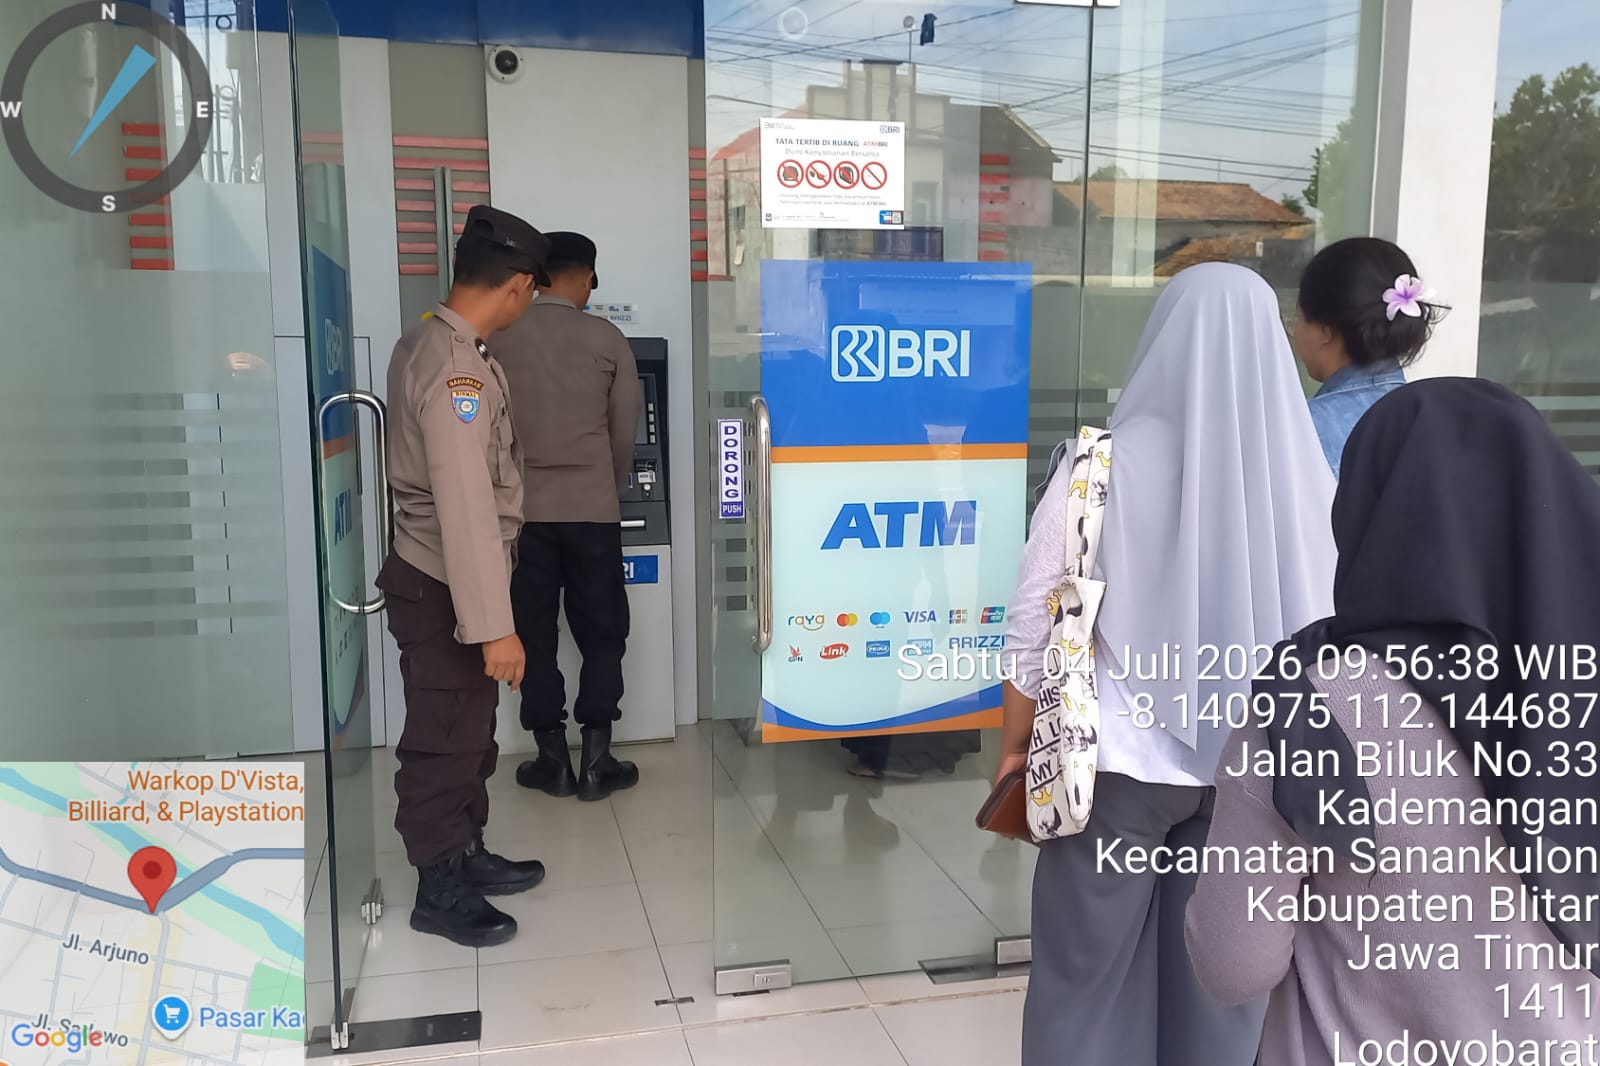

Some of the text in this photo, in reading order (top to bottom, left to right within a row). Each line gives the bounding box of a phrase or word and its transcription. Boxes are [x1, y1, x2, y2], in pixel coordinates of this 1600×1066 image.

[795, 138, 820, 146] TERTIB
[889, 329, 971, 378] BRI
[723, 425, 739, 499] DORONG
[722, 504, 742, 513] PUSH
[820, 500, 976, 550] ATM
[622, 561, 634, 579] RI
[788, 614, 825, 626] raya
[904, 610, 937, 623] VISA
[821, 643, 847, 658] Link
[948, 635, 1005, 649] BRIZZI
